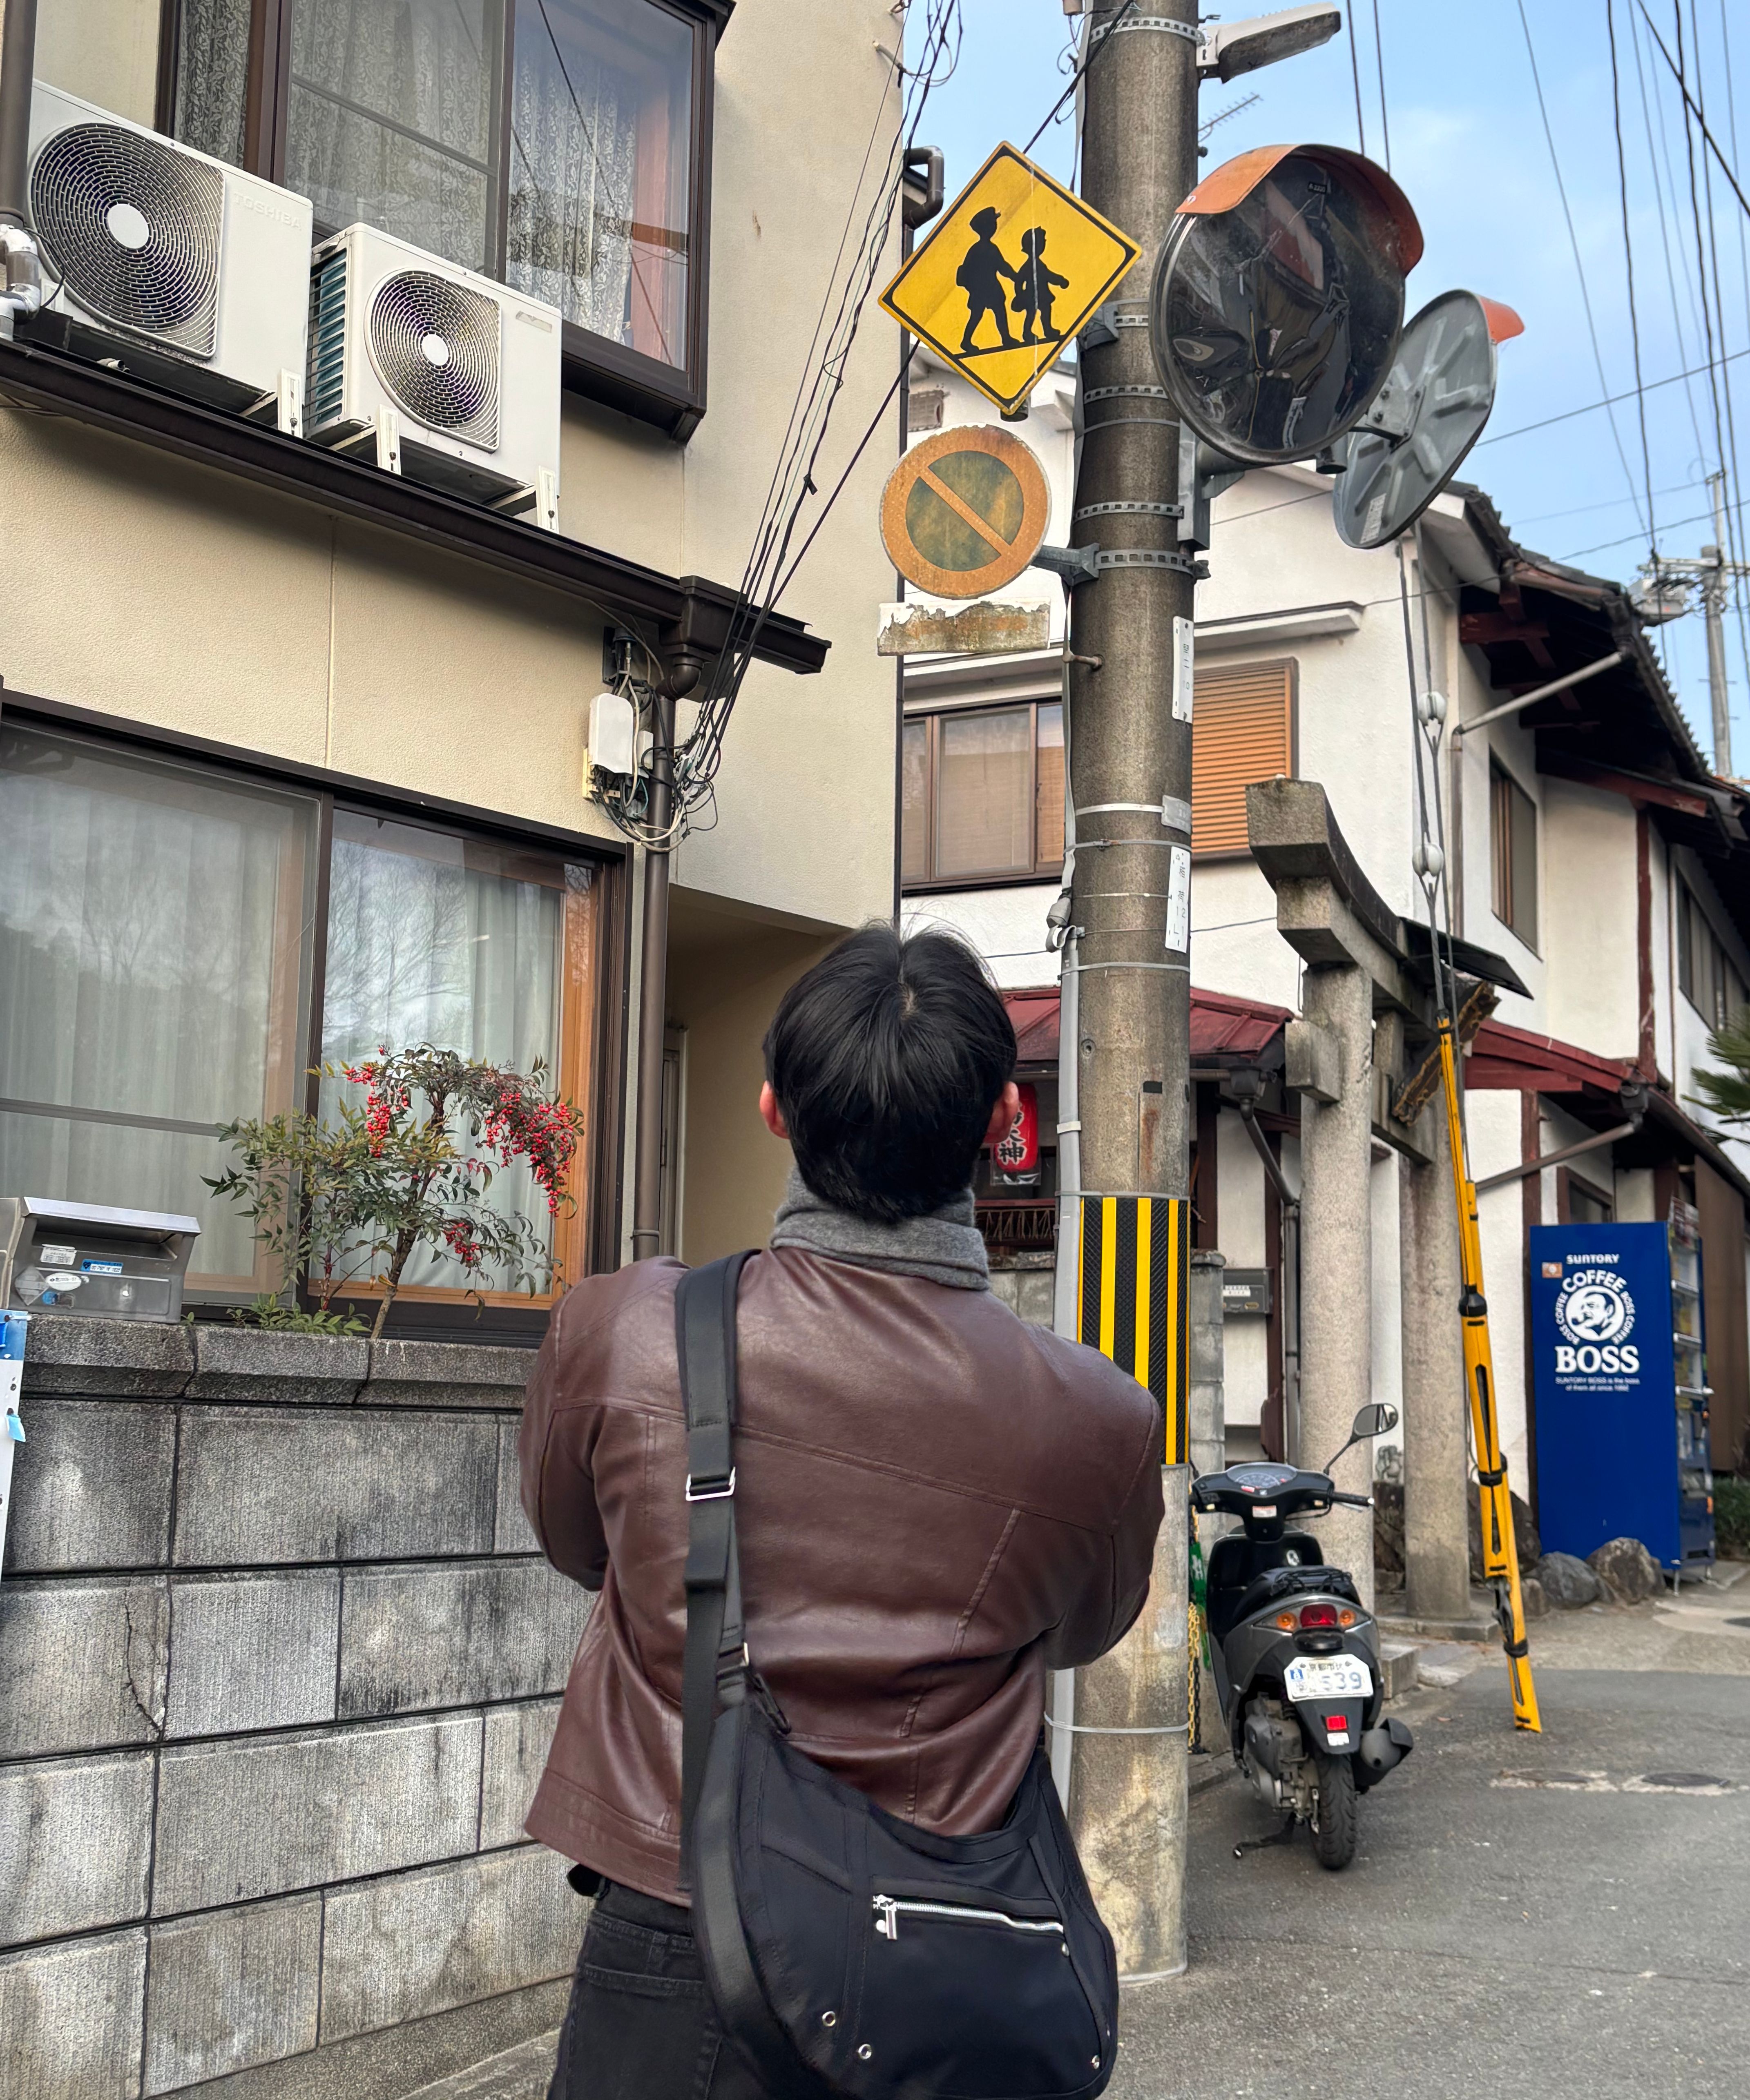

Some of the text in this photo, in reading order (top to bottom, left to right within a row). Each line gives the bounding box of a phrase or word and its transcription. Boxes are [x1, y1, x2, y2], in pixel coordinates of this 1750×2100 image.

[234, 192, 299, 228] TOSHIBA
[1566, 1253, 1620, 1264] SUNTORY
[1562, 1269, 1627, 1293] COFFEE
[1554, 1345, 1640, 1373] BOSS
